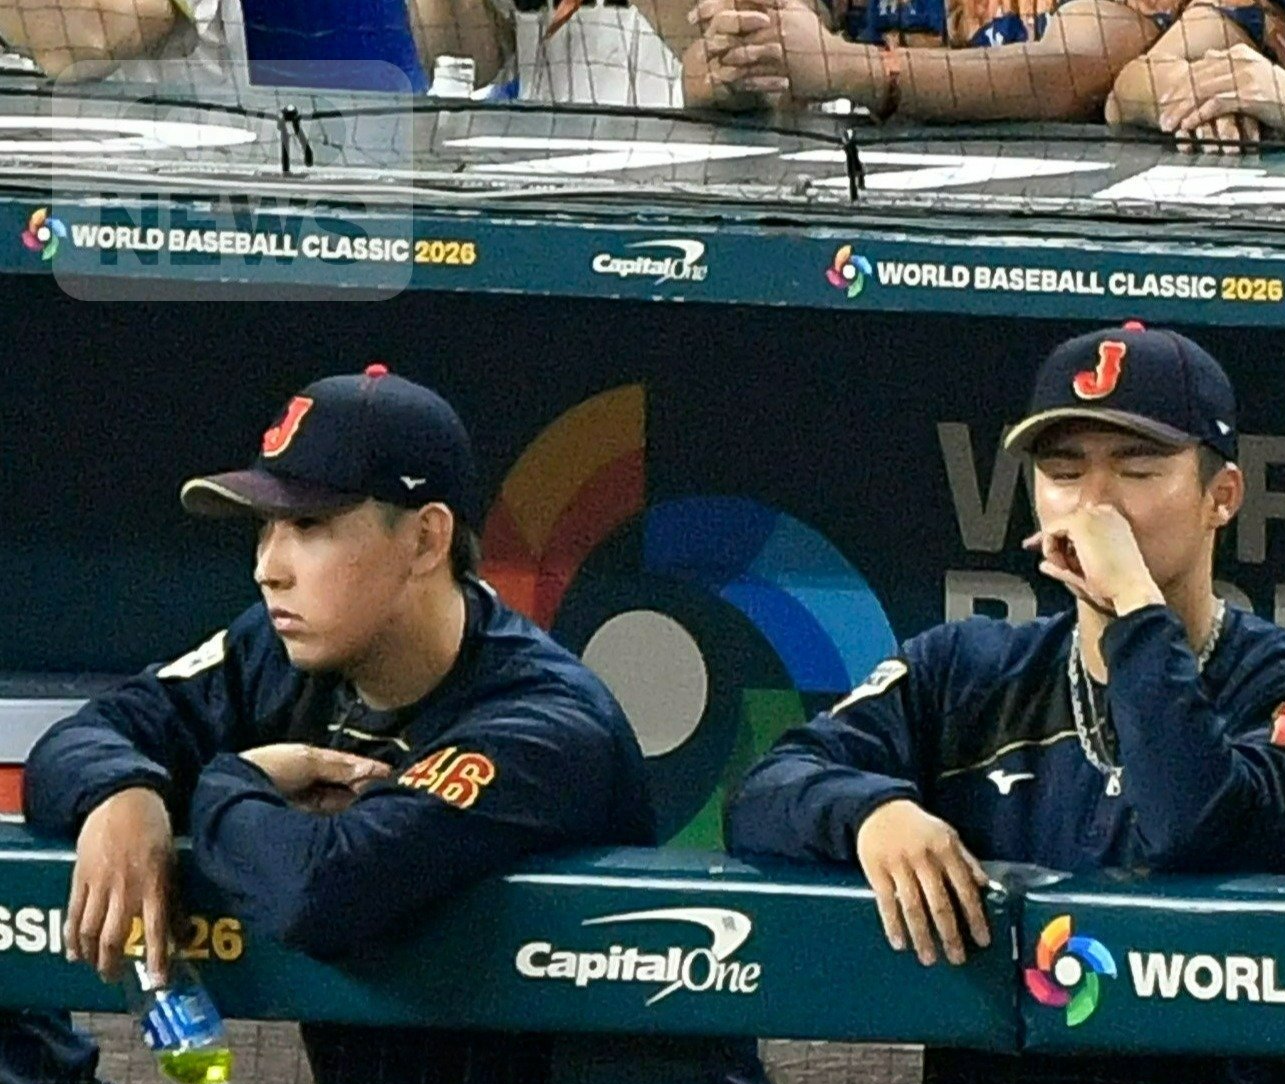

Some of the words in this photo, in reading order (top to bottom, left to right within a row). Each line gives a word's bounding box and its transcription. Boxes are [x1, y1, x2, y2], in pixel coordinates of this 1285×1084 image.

[71, 224, 165, 251] WORLD
[168, 230, 298, 258] BASEBALL
[302, 235, 410, 262] CLASSIC
[415, 239, 477, 266] 2026
[877, 262, 970, 288] WORLD
[974, 267, 1105, 295] BASEBALL
[1109, 273, 1217, 299] CLASSIC
[1221, 277, 1284, 301] 2026
[1073, 341, 1127, 400] J
[262, 397, 313, 458] J
[398, 746, 495, 809] 46
[124, 916, 243, 961] 226
